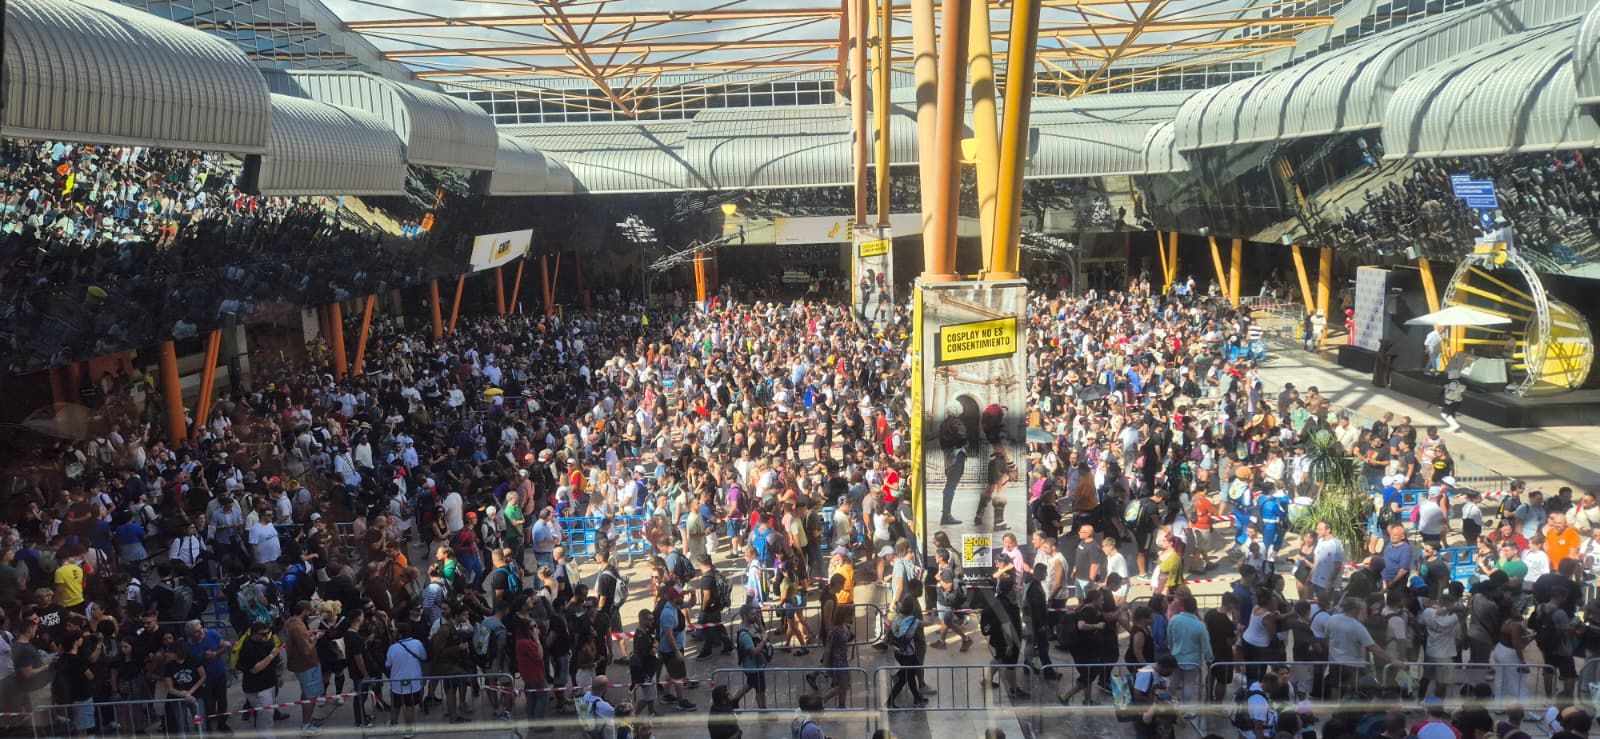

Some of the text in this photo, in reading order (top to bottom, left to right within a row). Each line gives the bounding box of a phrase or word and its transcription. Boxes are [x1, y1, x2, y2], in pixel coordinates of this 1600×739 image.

[947, 327, 1003, 343] COSPLAY NO ES
[947, 336, 1010, 353] CONSENTIMIENTO
